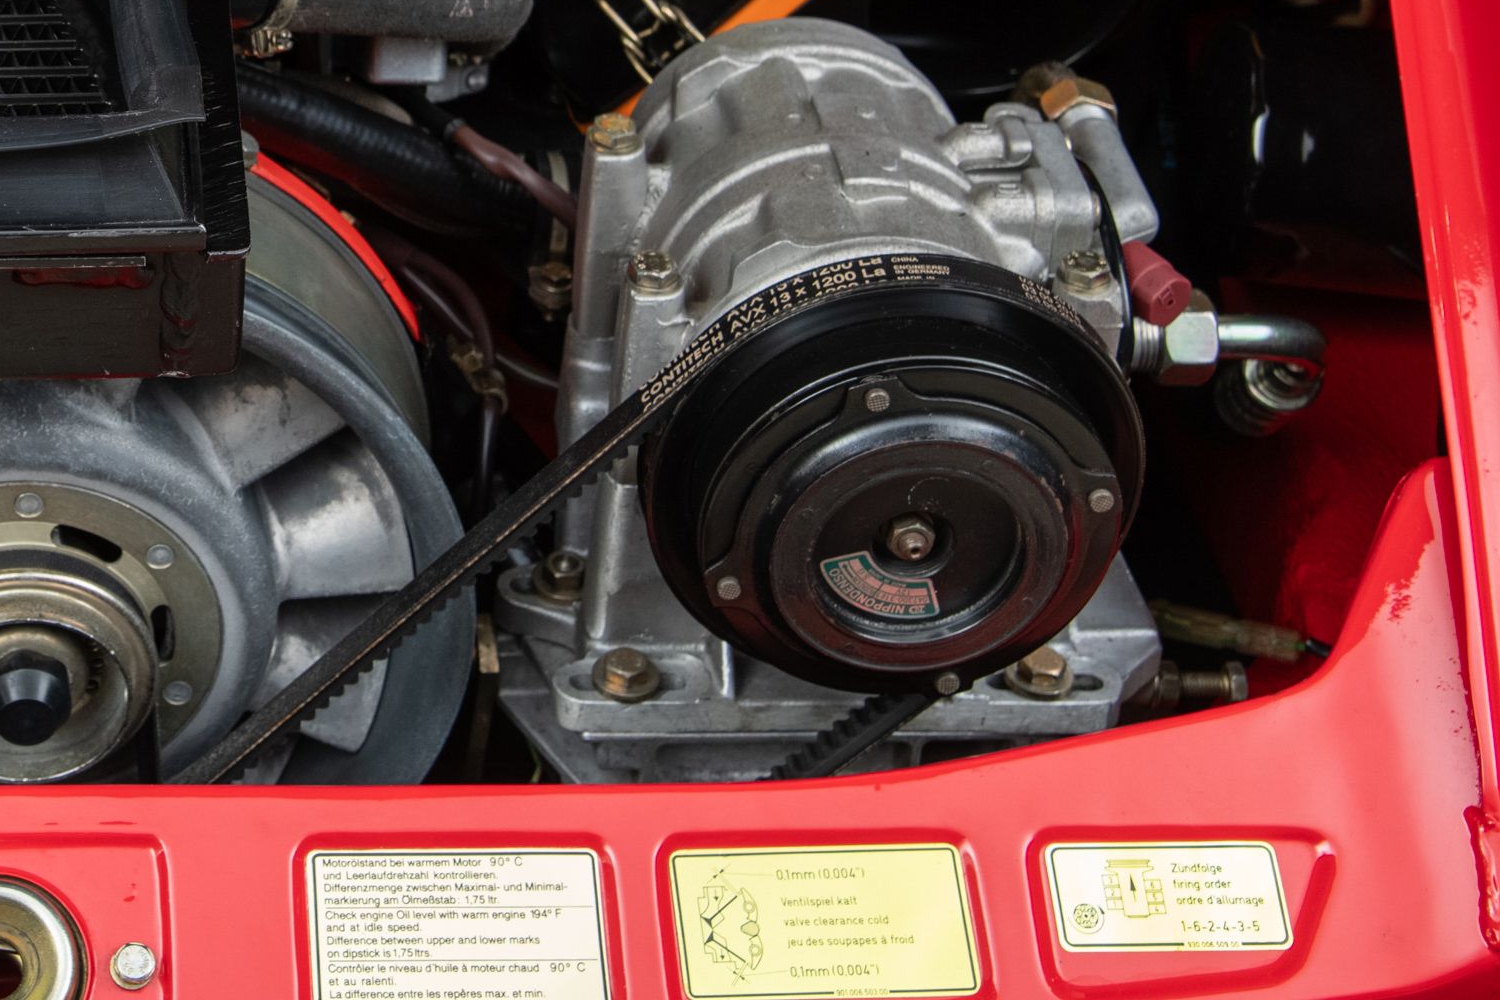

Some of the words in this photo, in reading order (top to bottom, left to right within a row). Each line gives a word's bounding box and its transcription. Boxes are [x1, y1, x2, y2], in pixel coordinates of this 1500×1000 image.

[641, 331, 724, 403] CONTITECH
[730, 304, 766, 333] AVX
[770, 292, 791, 307] 13
[796, 287, 807, 297] x
[812, 271, 856, 289] 1200
[862, 266, 886, 278] La
[829, 568, 905, 614] NIPPONDENSO
[323, 858, 387, 867] Motorölstand
[389, 858, 404, 867] bei
[406, 859, 450, 867] warmem
[453, 858, 481, 867] Motor
[489, 857, 510, 867] 90°
[514, 857, 523, 866] C
[323, 872, 341, 880] und
[346, 871, 429, 880] Leerlaufdrehzahl
[433, 871, 498, 880] kontrollieren.
[324, 883, 403, 894] Differenzmenge
[406, 883, 452, 892] zwischen
[455, 883, 500, 892] Maximal-
[503, 883, 523, 891] und
[525, 882, 568, 891] Minimal-
[1173, 880, 1200, 891] firing
[1204, 880, 1232, 889] order
[325, 895, 380, 908] markierung
[781, 896, 835, 908] Ventilspiel
[838, 896, 857, 905] kalt
[1176, 896, 1203, 905] ordre
[1206, 895, 1264, 907] d'allumage
[325, 910, 357, 920] Check
[360, 910, 393, 921] engine
[396, 910, 410, 919] Oil
[413, 910, 436, 919] level
[439, 910, 459, 919] with
[492, 910, 525, 921] engine
[530, 910, 552, 919] 194°
[556, 909, 562, 918] F
[784, 917, 810, 926] valve
[813, 916, 864, 925] clearance
[868, 916, 889, 925] cold
[326, 923, 345, 932] and
[350, 924, 360, 932] at
[364, 923, 383, 932] idle
[387, 923, 421, 935] speed.
[1181, 921, 1260, 932] 1-6-2-4-3-5
[326, 936, 378, 946] Difference
[380, 936, 424, 945] between
[426, 937, 455, 947] upper
[458, 936, 477, 945] and
[479, 936, 506, 945] lower
[509, 935, 540, 945] marks
[787, 936, 803, 947] jeu
[806, 936, 824, 945] des
[827, 936, 877, 947] soupapes
[881, 935, 887, 945] à
[890, 935, 914, 944] froid
[343, 949, 379, 960] dipstick
[383, 949, 391, 958] is
[328, 963, 374, 973] Contrôler
[377, 964, 386, 973] le
[389, 964, 423, 973] niveau
[462, 963, 468, 972] à
[471, 964, 506, 972] moteur
[508, 963, 540, 972] chaud
[550, 963, 571, 972] 90°
[577, 963, 586, 972] C
[329, 977, 339, 986] et
[344, 978, 357, 986] au
[361, 976, 397, 986] ralenti.
[329, 989, 342, 999] La
[397, 990, 424, 999] entre
[426, 989, 441, 998] les
[512, 989, 522, 998] et
[525, 989, 546, 998] min.
